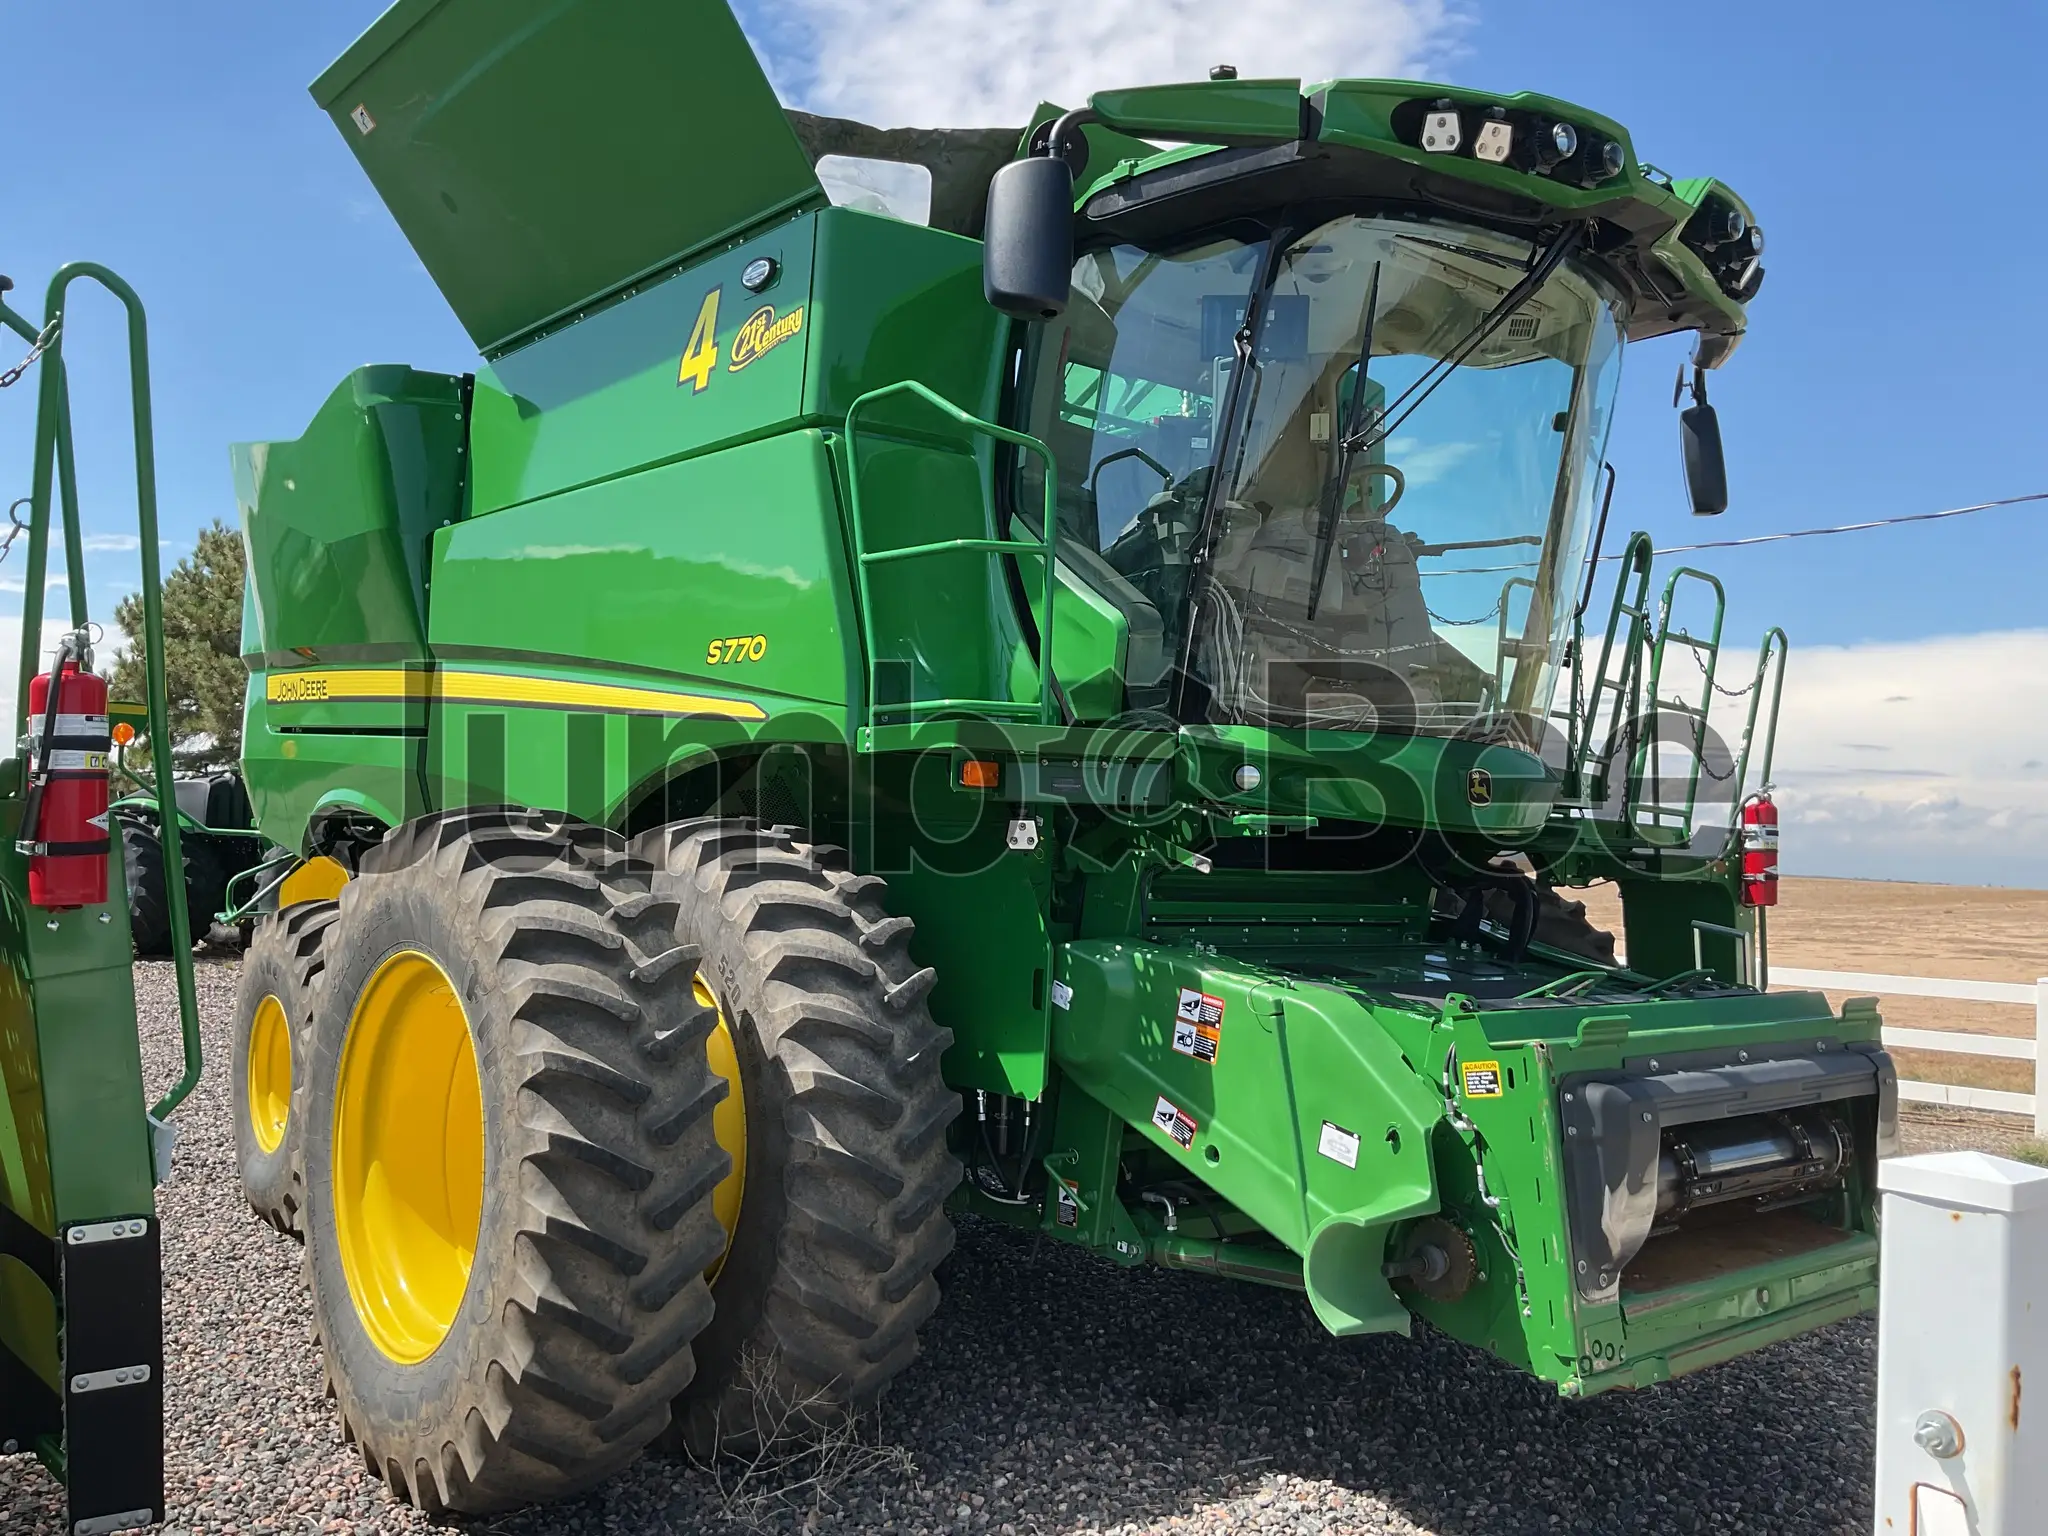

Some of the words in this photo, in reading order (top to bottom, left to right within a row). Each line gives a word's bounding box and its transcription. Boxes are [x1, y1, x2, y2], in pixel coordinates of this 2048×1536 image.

[677, 282, 723, 395] 4
[706, 634, 767, 665] S770
[276, 679, 299, 700] JOHN
[299, 677, 328, 698] DEERE
[1469, 1062, 1497, 1070] CAUTION
